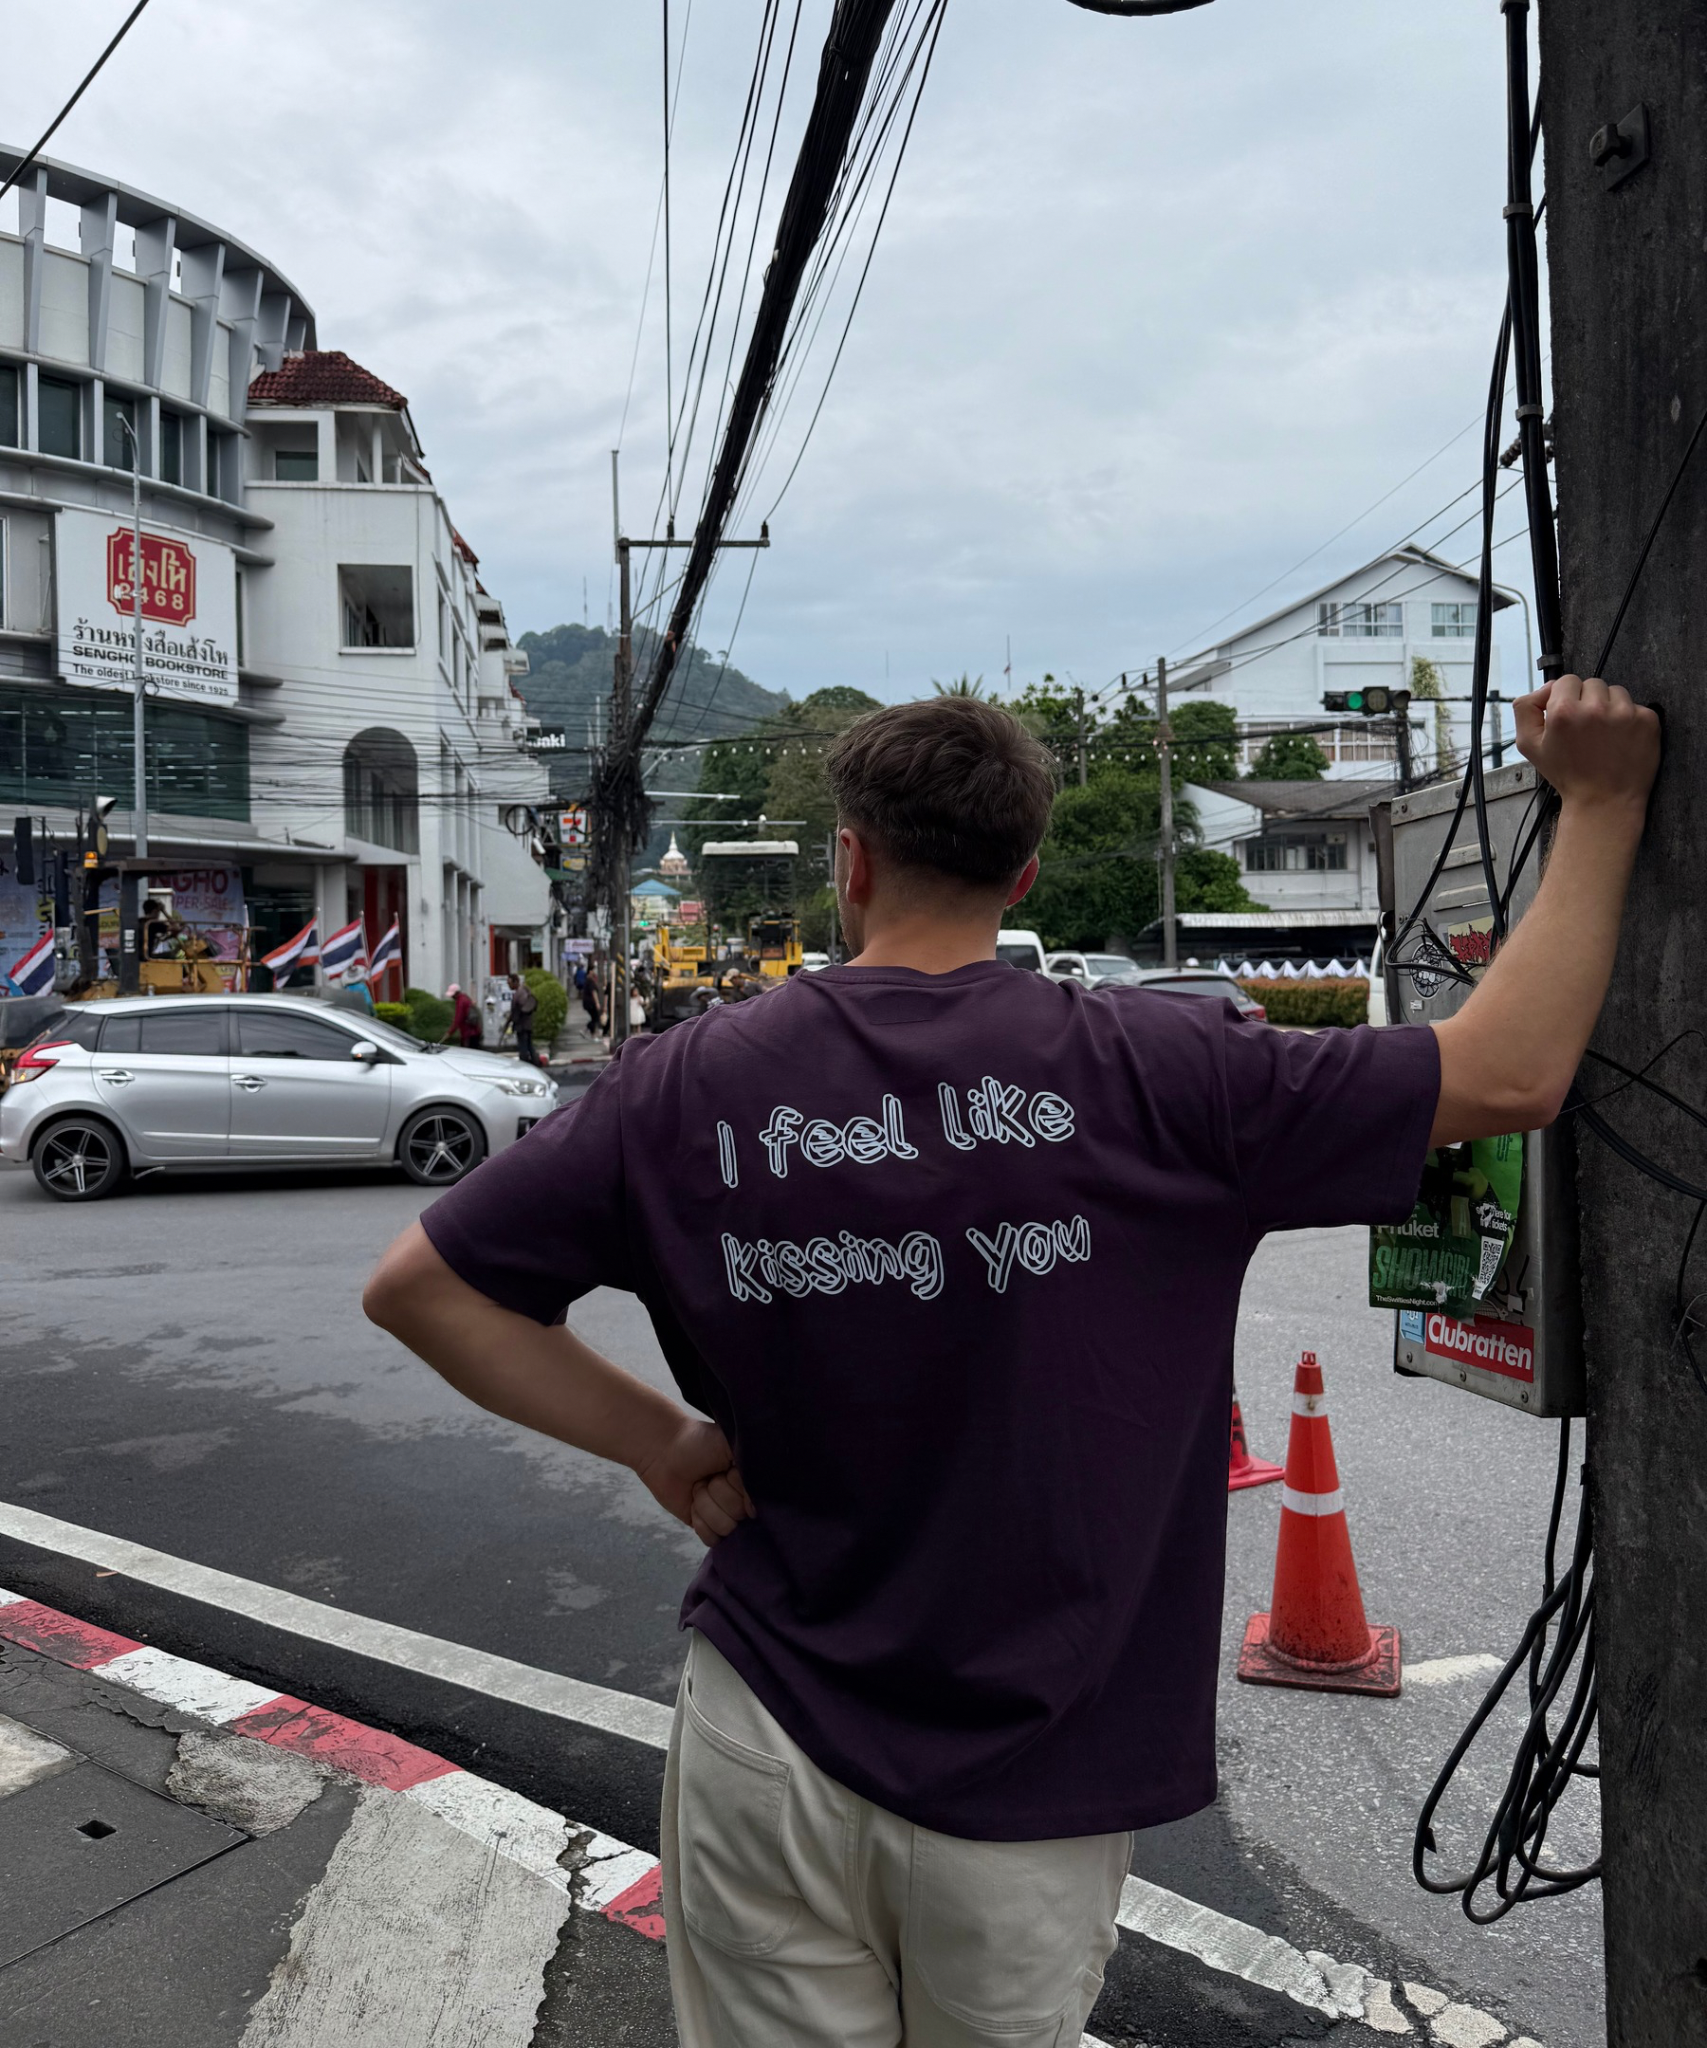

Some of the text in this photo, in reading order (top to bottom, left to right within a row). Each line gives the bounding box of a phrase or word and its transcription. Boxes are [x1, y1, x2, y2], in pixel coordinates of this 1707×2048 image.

[73, 663, 94, 675] The
[98, 666, 129, 681] oldest
[131, 670, 180, 687] okstore
[182, 679, 206, 693] since
[146, 656, 229, 680] BOOKSTORE
[759, 1093, 919, 1179] feel
[937, 1075, 1075, 1151] like
[721, 1214, 1091, 1305] kissing you
[1428, 1314, 1532, 1370] Clubratten
